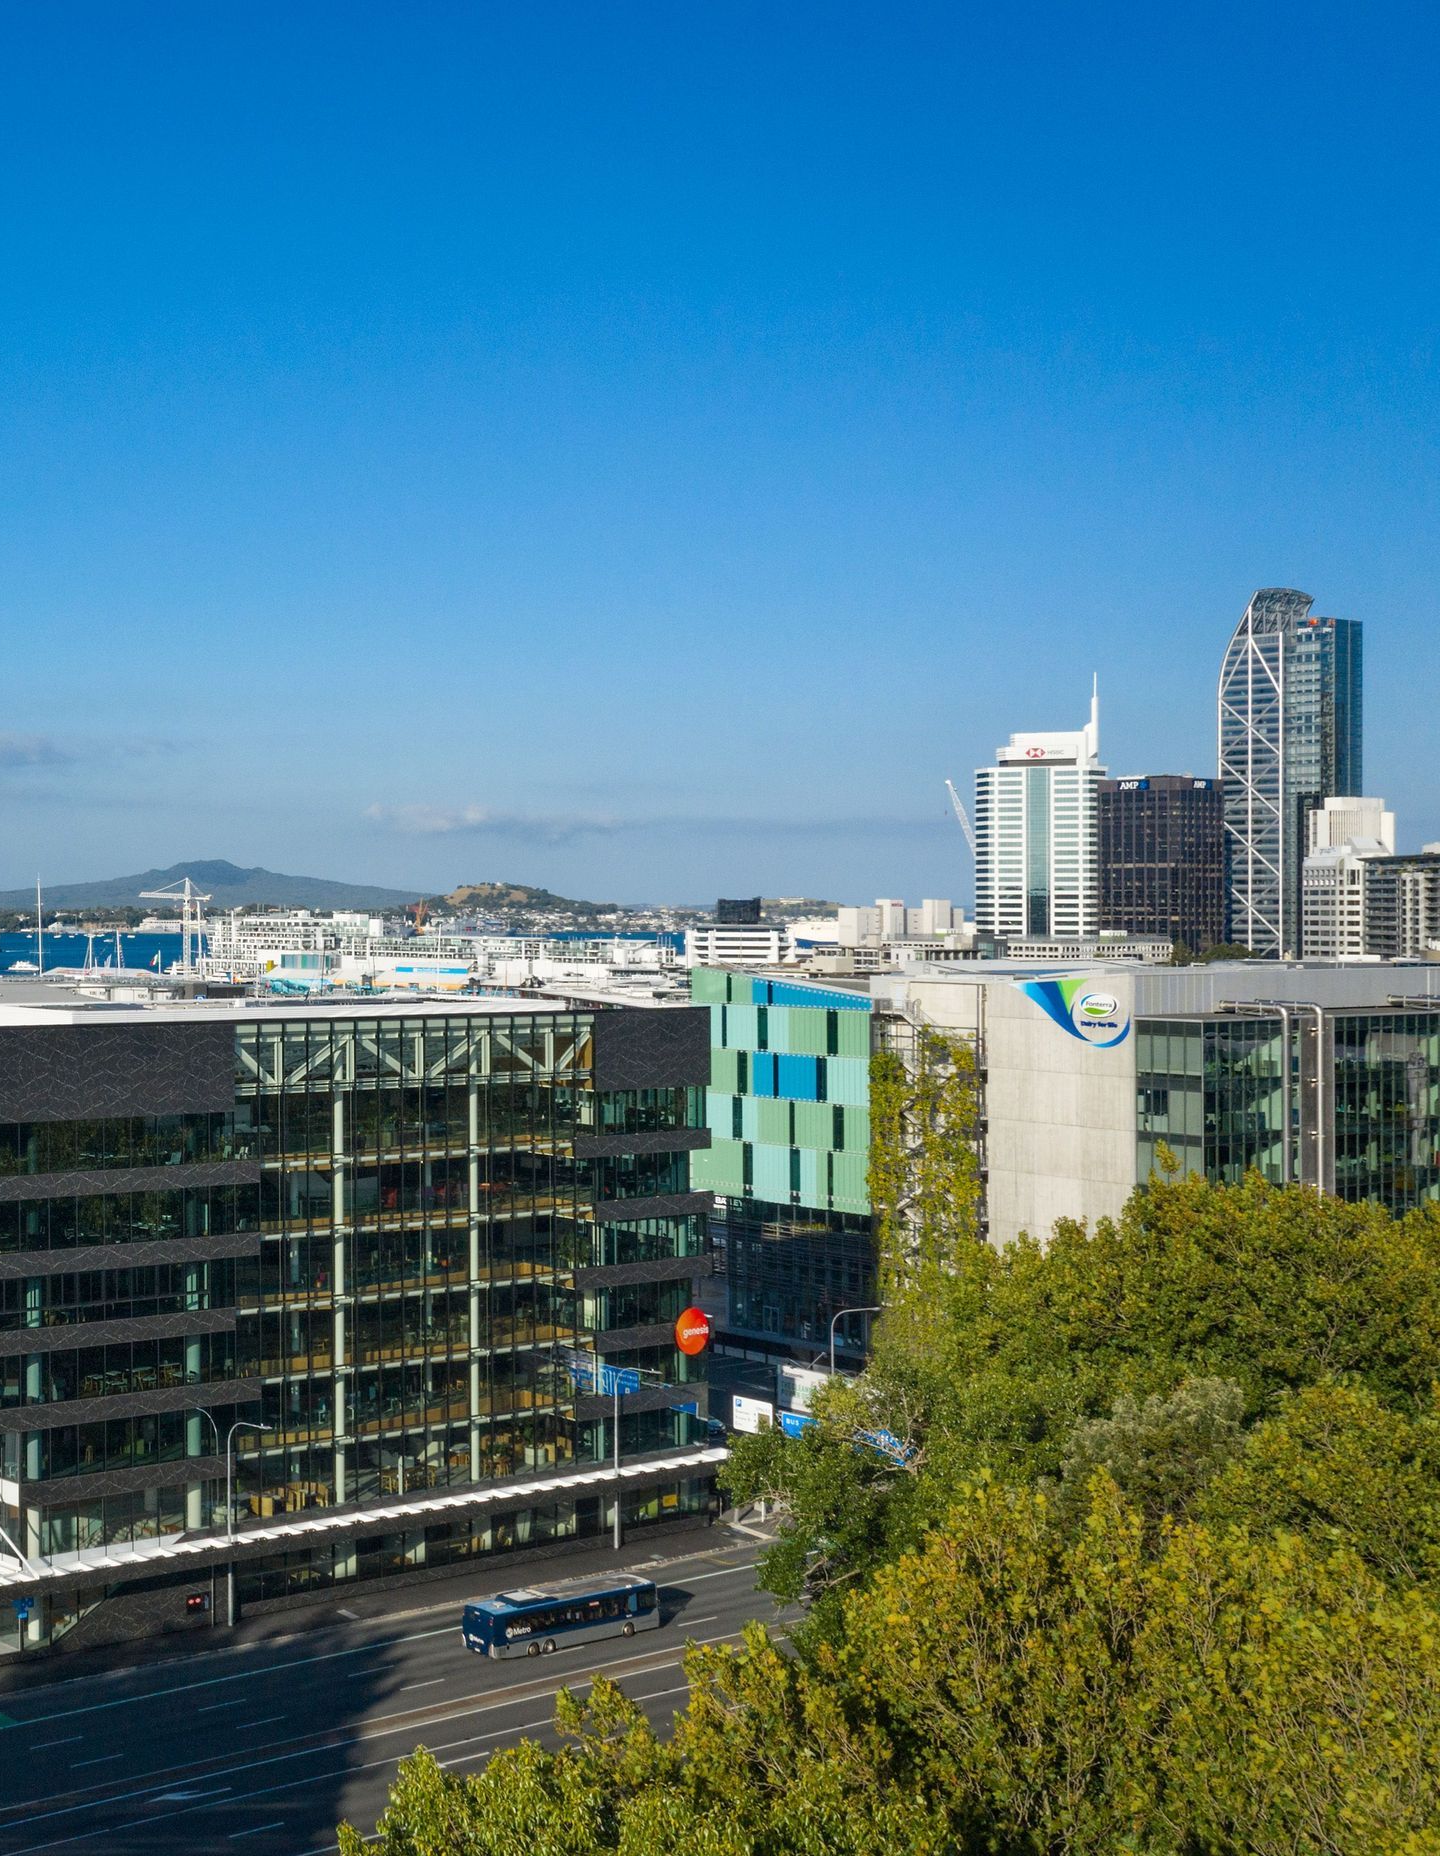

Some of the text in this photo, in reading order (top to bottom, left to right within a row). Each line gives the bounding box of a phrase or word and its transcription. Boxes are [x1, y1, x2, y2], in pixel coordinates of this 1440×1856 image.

[1120, 781, 1139, 790] AMP
[1193, 780, 1206, 789] AMP
[683, 1324, 709, 1339] genesis
[513, 1626, 531, 1636] Metro
